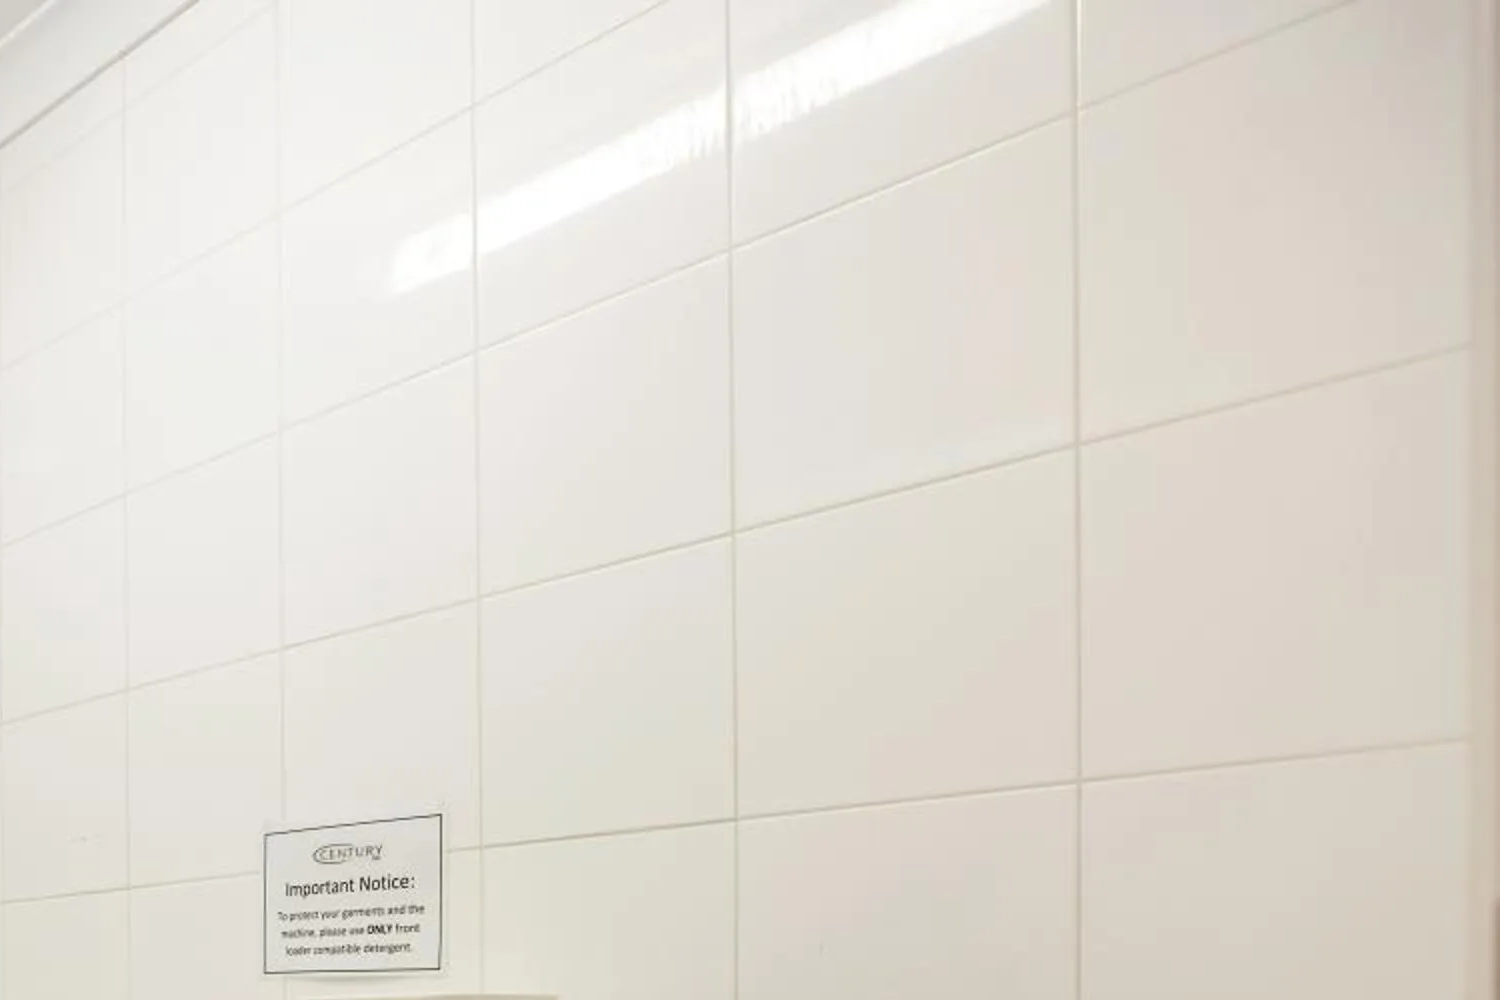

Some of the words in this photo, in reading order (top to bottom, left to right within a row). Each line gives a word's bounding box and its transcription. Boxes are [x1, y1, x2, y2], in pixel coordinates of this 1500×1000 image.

[319, 844, 382, 861] CENTURY
[285, 879, 354, 898] Important
[359, 875, 415, 892] Notice:
[278, 911, 289, 921] To
[290, 911, 319, 922] protect
[321, 909, 340, 920] your
[342, 908, 385, 920] garments
[388, 905, 406, 915] and
[408, 904, 425, 914] the
[281, 928, 317, 938] machine,
[320, 927, 347, 937] please
[349, 927, 365, 936] use
[367, 923, 393, 935] ONLY
[396, 923, 420, 934] front
[286, 945, 312, 956] loader
[313, 944, 361, 955] compatible
